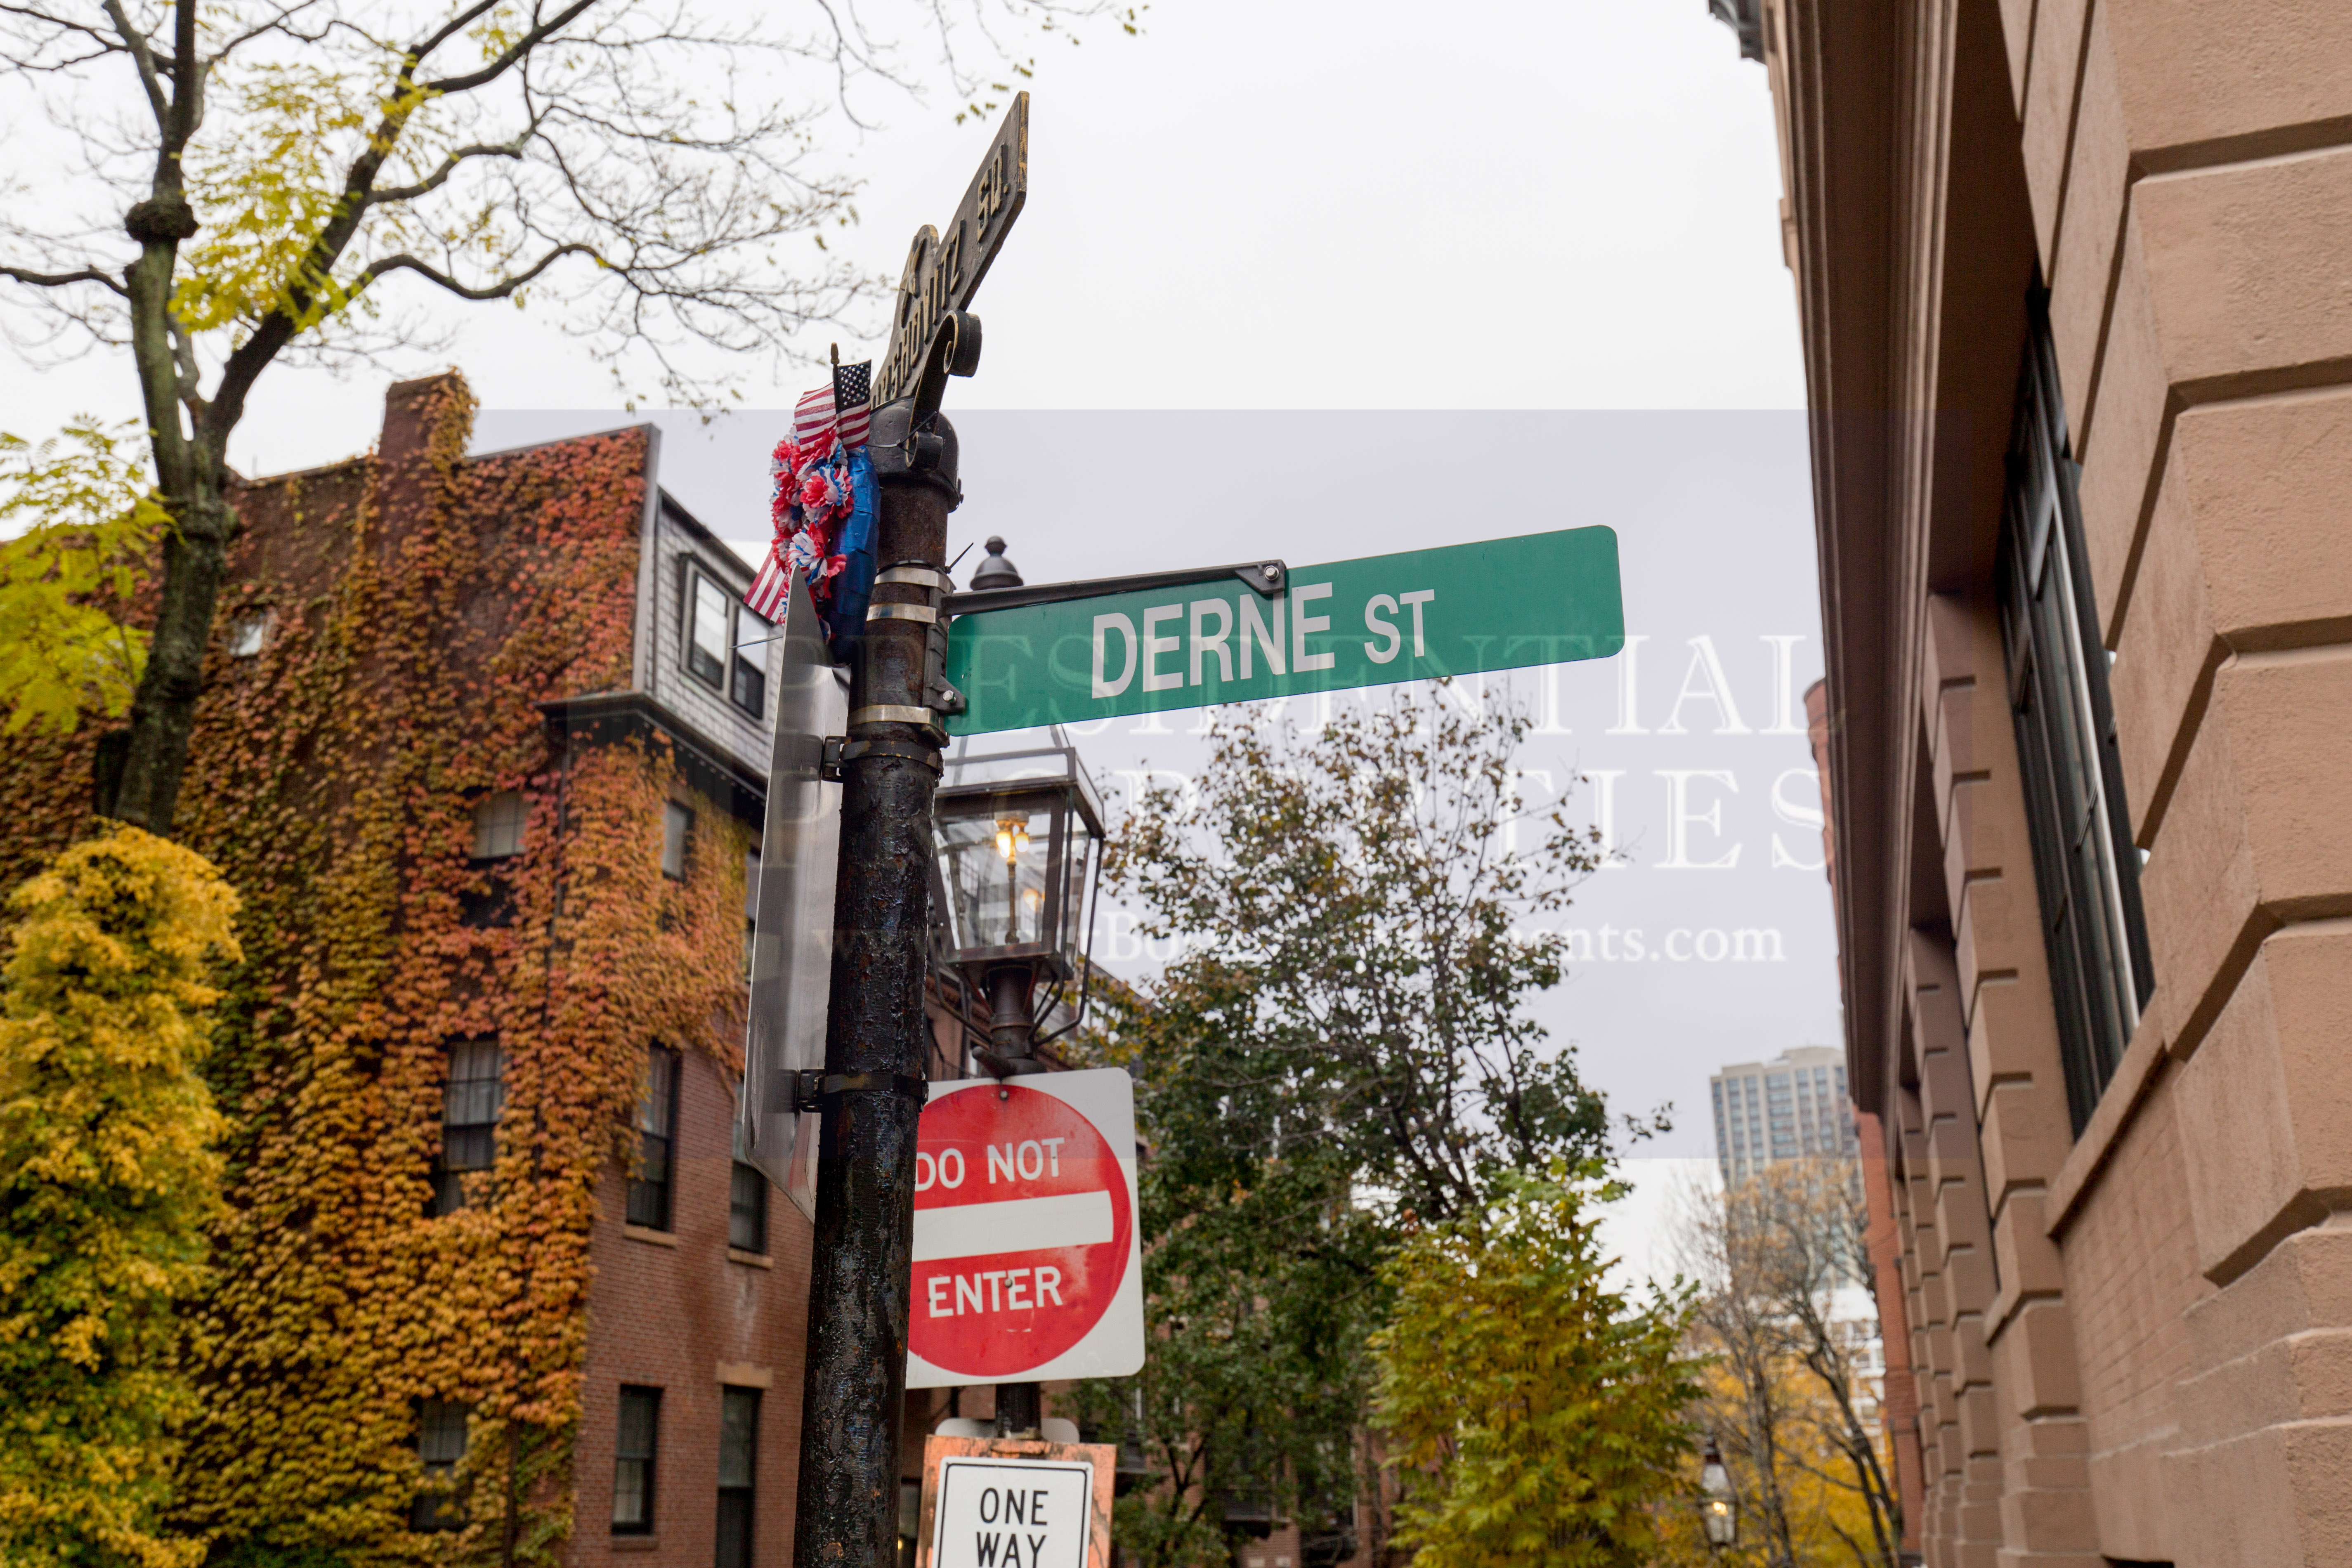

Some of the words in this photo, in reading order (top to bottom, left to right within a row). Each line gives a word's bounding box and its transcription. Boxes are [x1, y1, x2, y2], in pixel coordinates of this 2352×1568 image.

[977, 145, 1008, 243] SQ.
[1091, 581, 1335, 699] DERNE
[1365, 589, 1435, 665] ST
[916, 1148, 965, 1192] DO
[987, 1137, 1065, 1184] NOT
[928, 1266, 1063, 1318] ENTER
[980, 1488, 1048, 1526] ONE
[976, 1531, 1047, 1568] WAY
